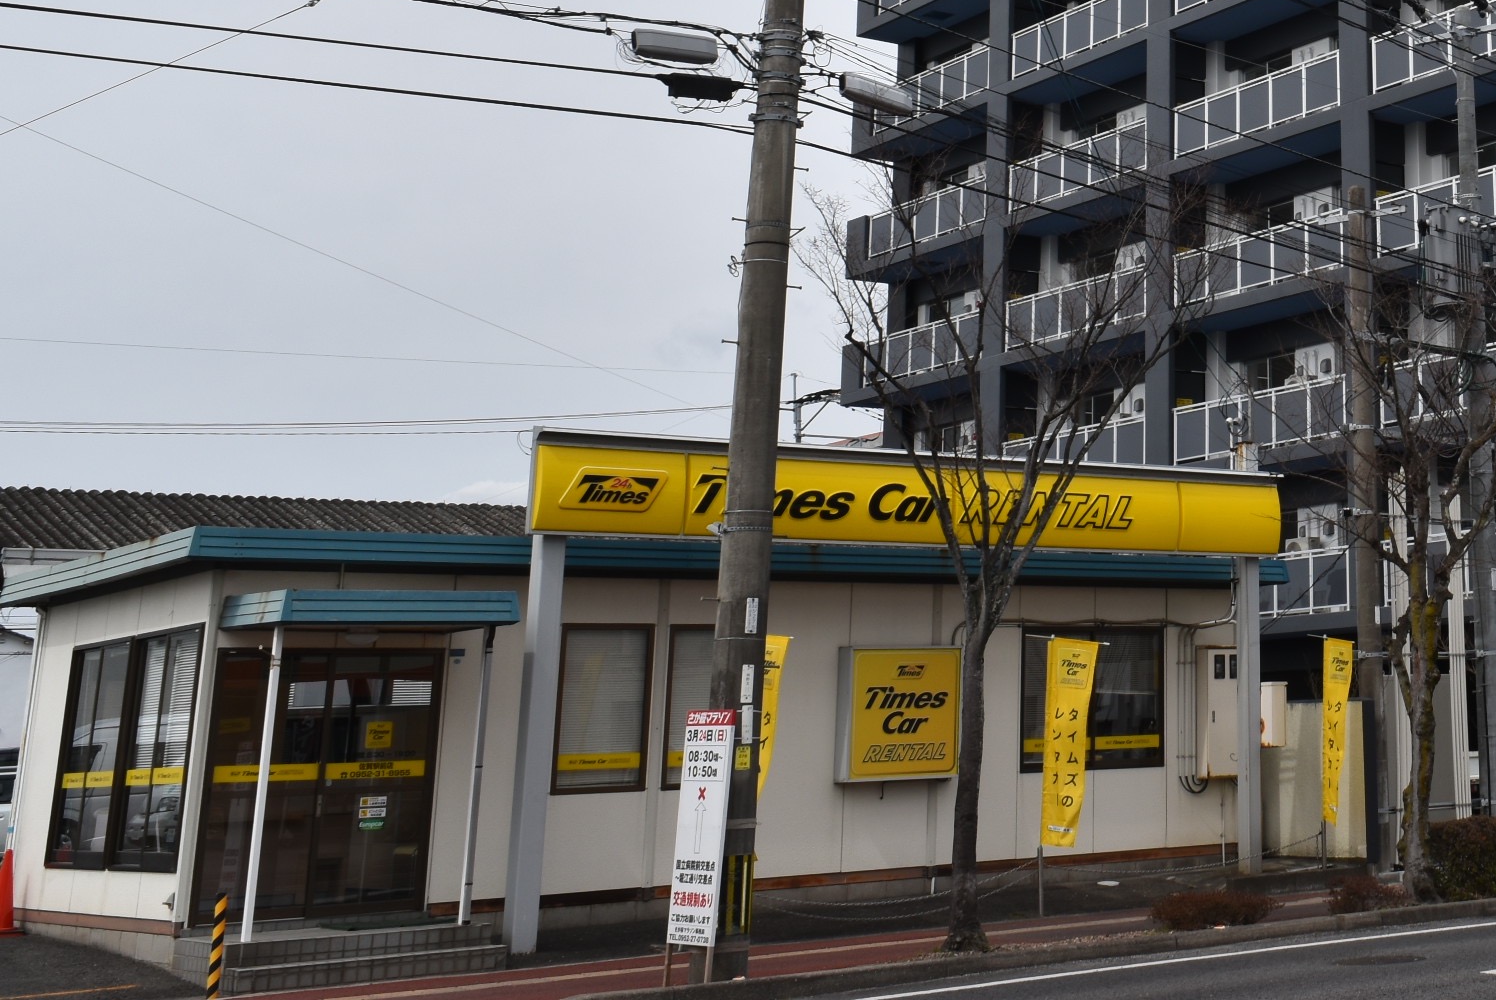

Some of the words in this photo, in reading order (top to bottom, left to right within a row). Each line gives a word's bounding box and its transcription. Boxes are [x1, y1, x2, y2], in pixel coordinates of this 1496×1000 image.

[577, 475, 653, 505] Times
[693, 474, 856, 521] Tes
[896, 665, 923, 678] Times
[1061, 659, 1088, 669] Times
[1066, 668, 1080, 676] Car
[865, 686, 949, 710] Times
[882, 710, 930, 735] Car
[686, 728, 728, 742] 3月24日(日)
[862, 742, 947, 763] RENTAL
[1061, 707, 1079, 808] タイムズの
[358, 821, 385, 829] Europcar
[672, 890, 714, 908] 交通規制あり
